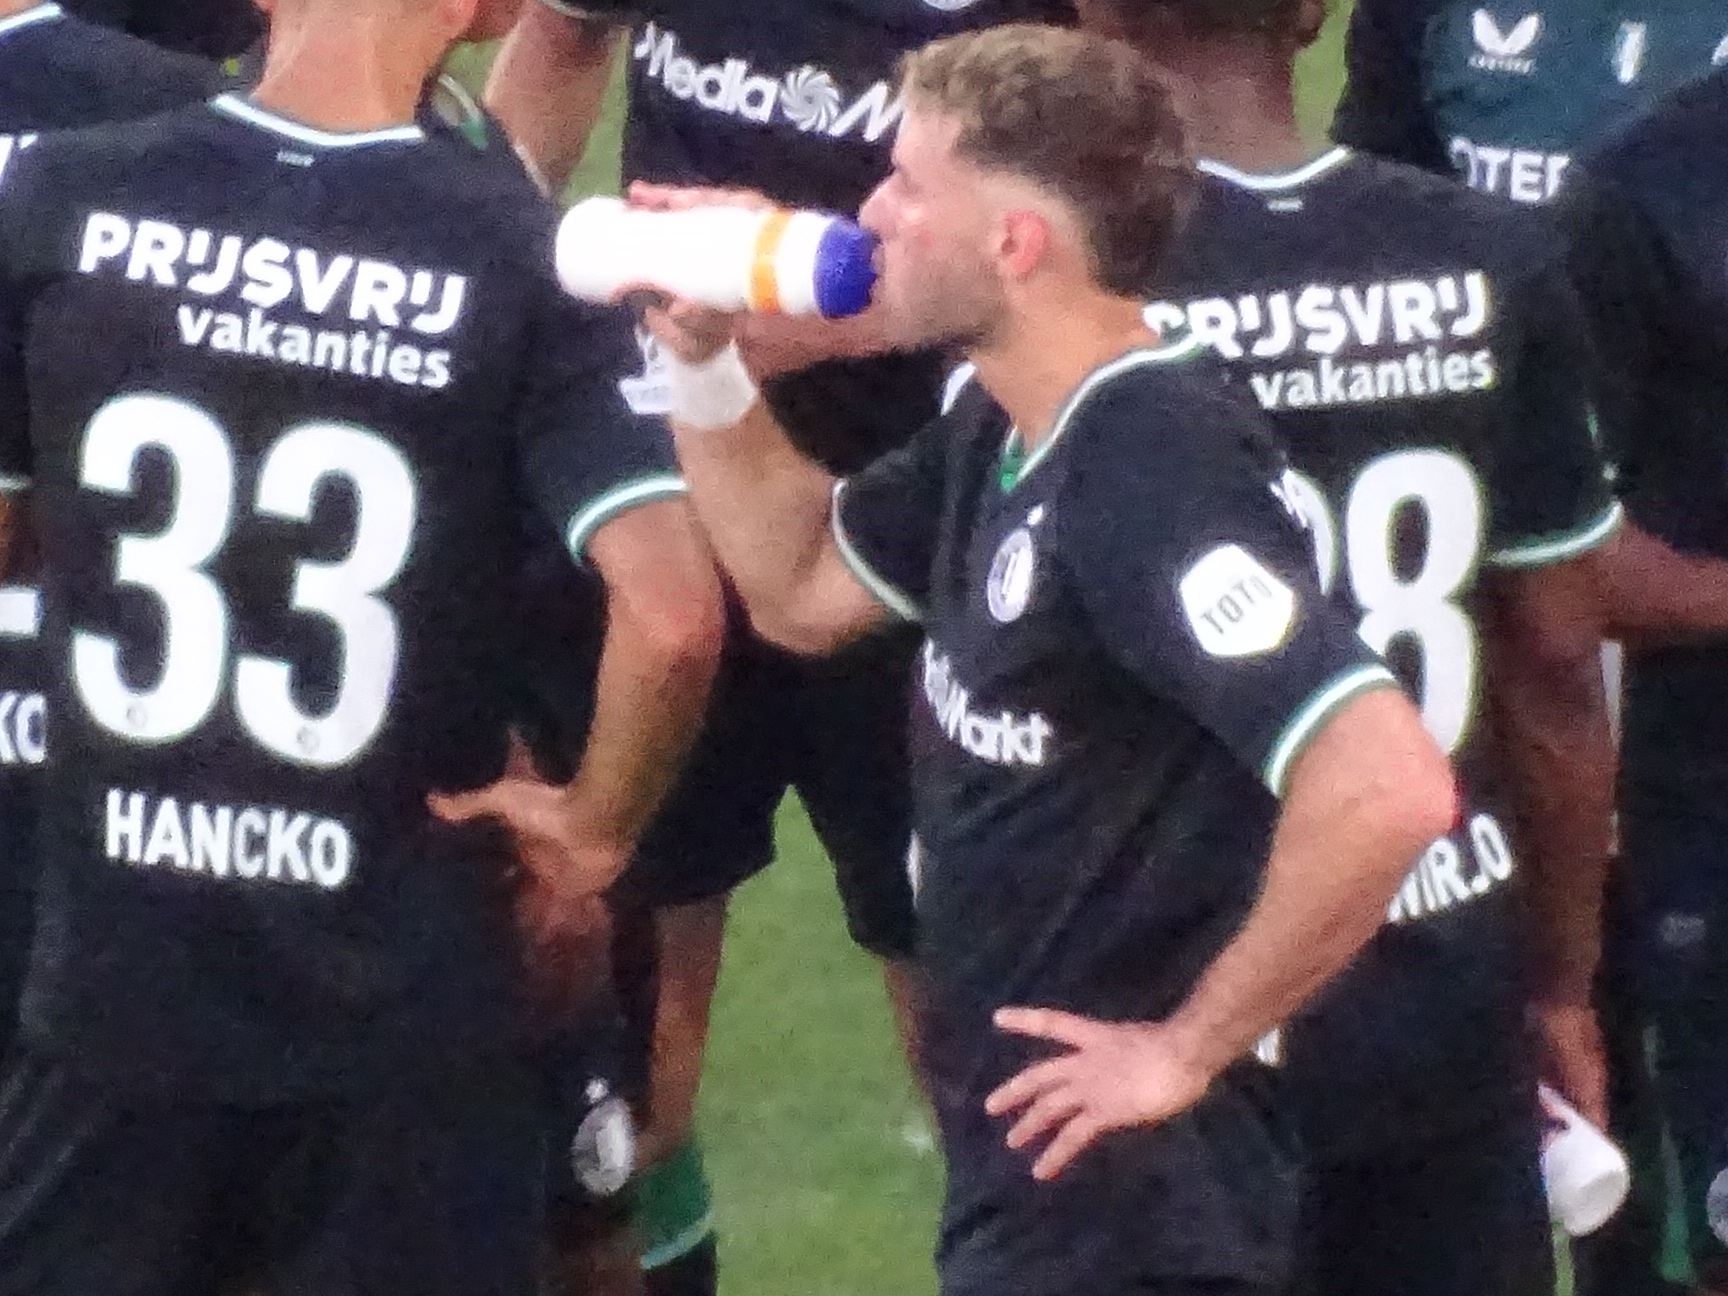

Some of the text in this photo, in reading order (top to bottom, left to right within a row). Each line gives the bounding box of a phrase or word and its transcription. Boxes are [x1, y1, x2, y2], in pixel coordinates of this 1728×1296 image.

[177, 303, 455, 389] vakanties
[1250, 345, 1495, 410] vakanties
[72, 391, 419, 769] 33
[1199, 575, 1274, 636] TOTO
[105, 788, 354, 889] HANCKO
